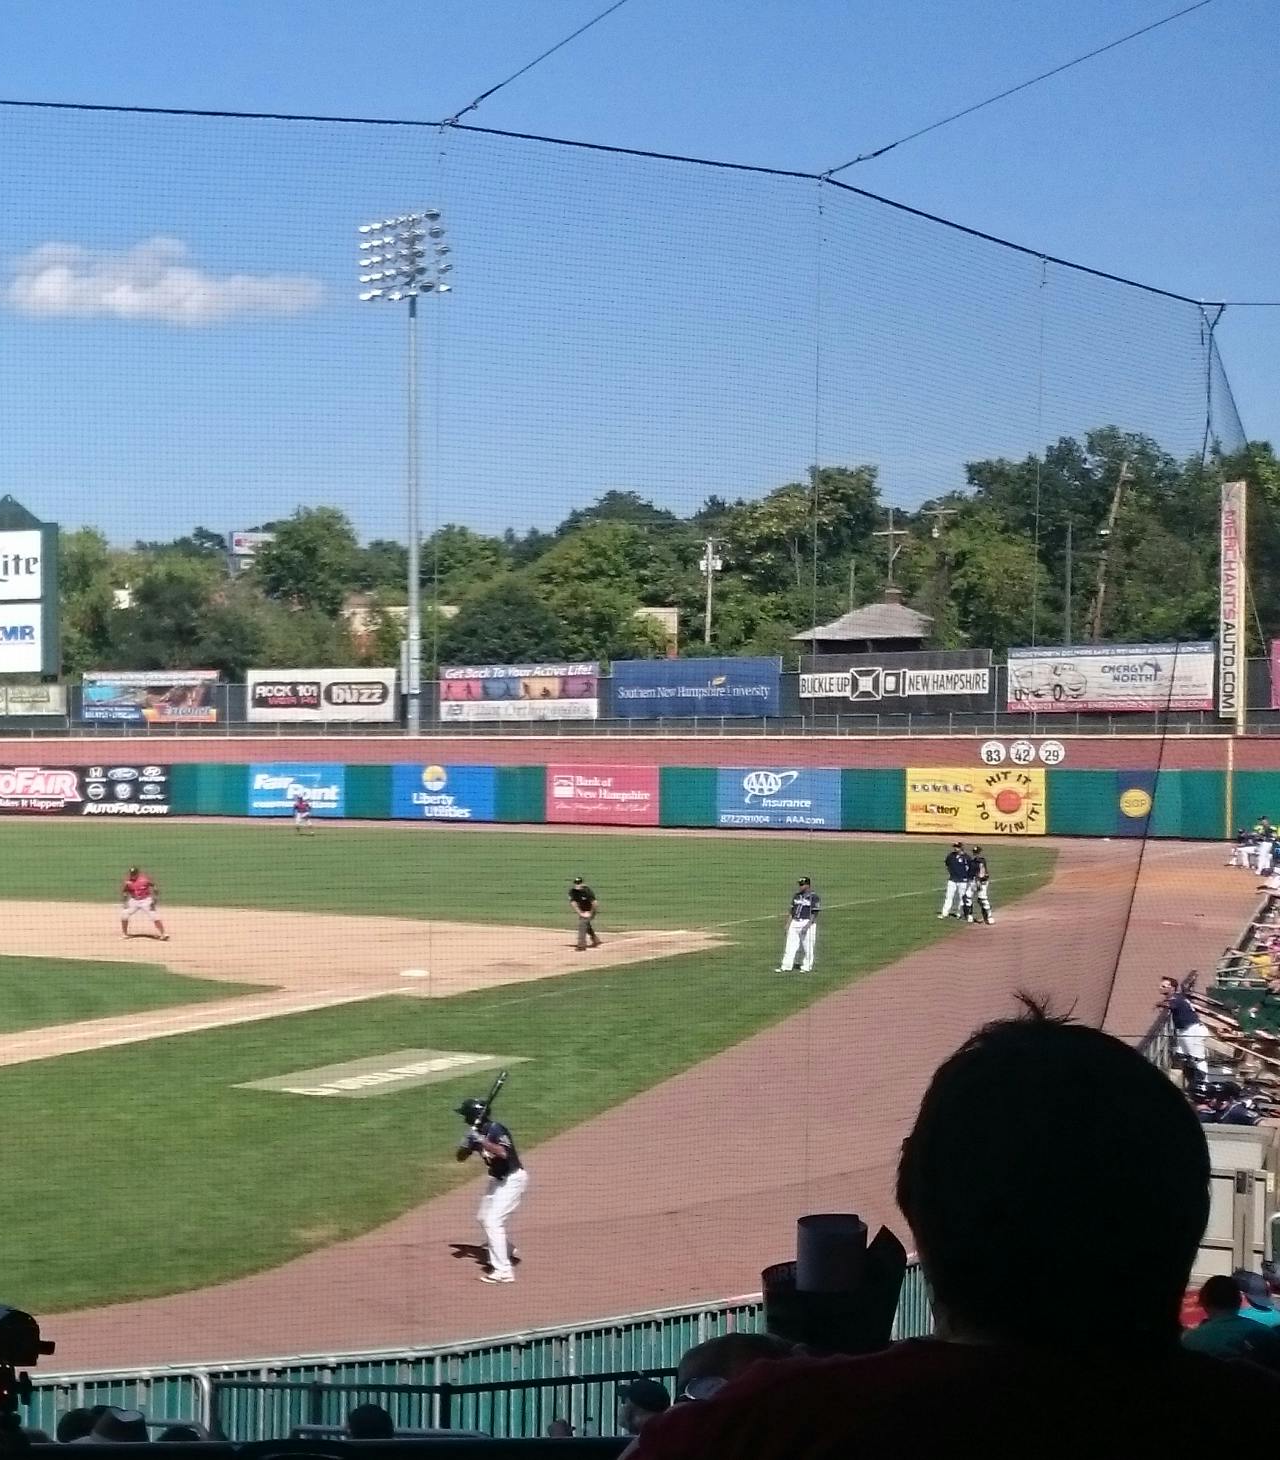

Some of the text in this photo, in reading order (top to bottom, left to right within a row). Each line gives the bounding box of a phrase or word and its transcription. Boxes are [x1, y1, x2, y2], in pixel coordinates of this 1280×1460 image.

[445, 664, 593, 679] Get Back To Your Active Life!
[1112, 673, 1153, 683] NORTH
[801, 677, 850, 693] BUCKLE UP
[909, 672, 987, 691] NEW HAMPSHIRE
[256, 685, 318, 699] ROCK 101
[331, 685, 383, 703] buzz
[617, 684, 771, 700] Southern New Hampshire University
[986, 749, 1001, 762] 83
[1014, 749, 1030, 762] 42
[1044, 749, 1060, 762] 29
[575, 776, 613, 787] Bank of
[985, 771, 1032, 787] HIT IT
[286, 784, 340, 800] Point
[575, 788, 650, 802] New Hampshire
[30, 799, 65, 810] Happen!
[412, 793, 455, 807] Liberty
[762, 798, 812, 808] Insurance
[424, 806, 471, 818] Utilities
[976, 801, 990, 821] TO
[994, 820, 1025, 833] WIN
